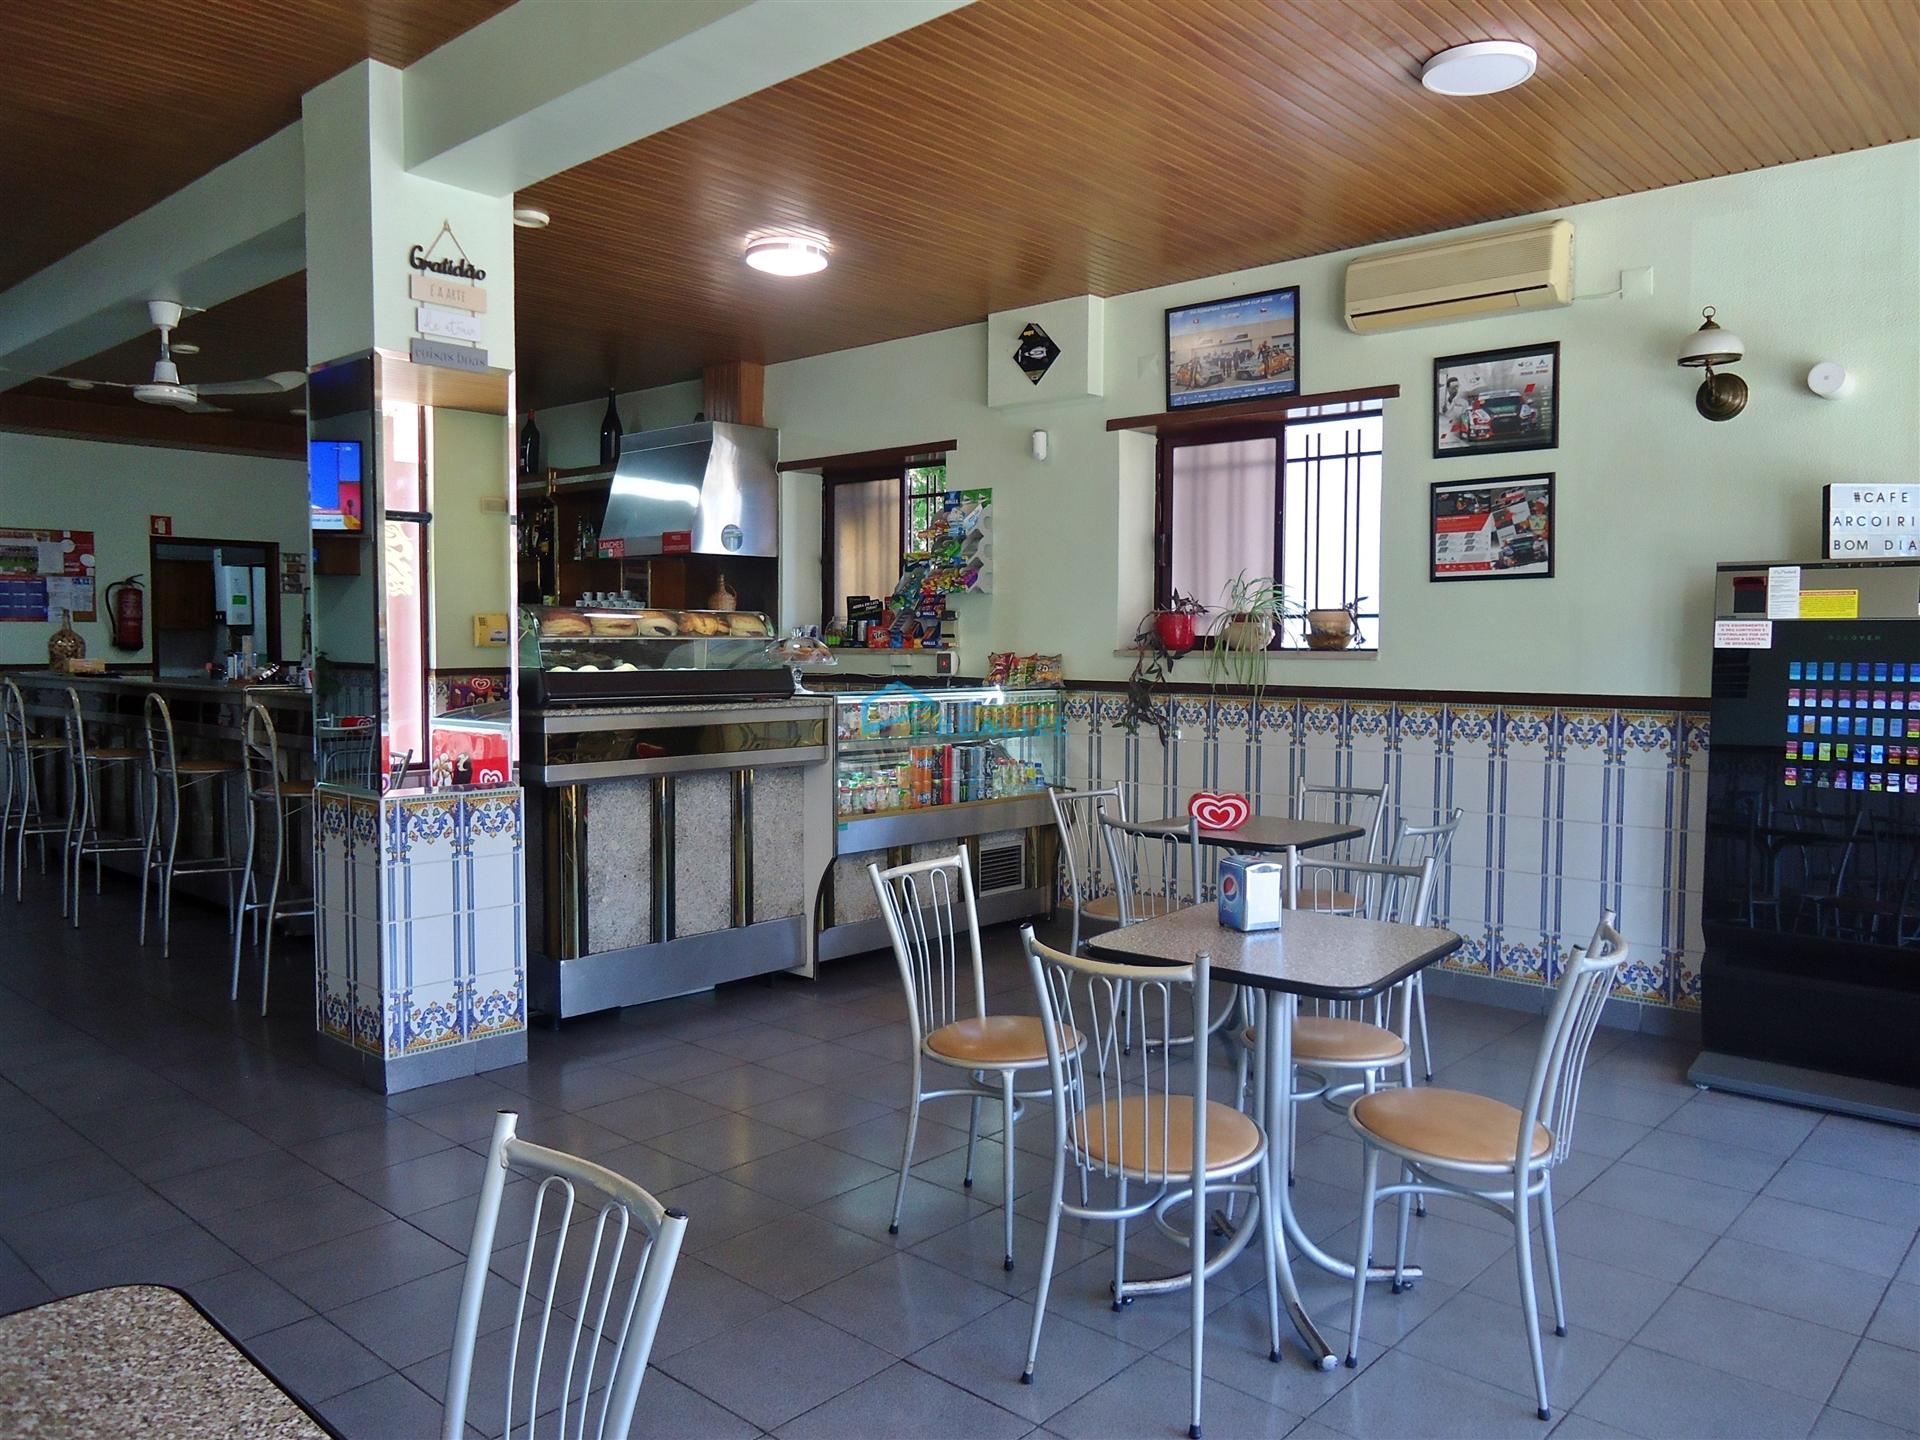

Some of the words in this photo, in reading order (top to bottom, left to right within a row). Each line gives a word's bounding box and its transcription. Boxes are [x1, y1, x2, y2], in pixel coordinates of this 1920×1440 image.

[409, 245, 486, 280] Gratidão
[1853, 492, 1909, 503] #CAFE
[1832, 516, 1915, 527] ARCOIRI
[1833, 540, 1869, 551] BOM
[1884, 539, 1918, 551] DIA
